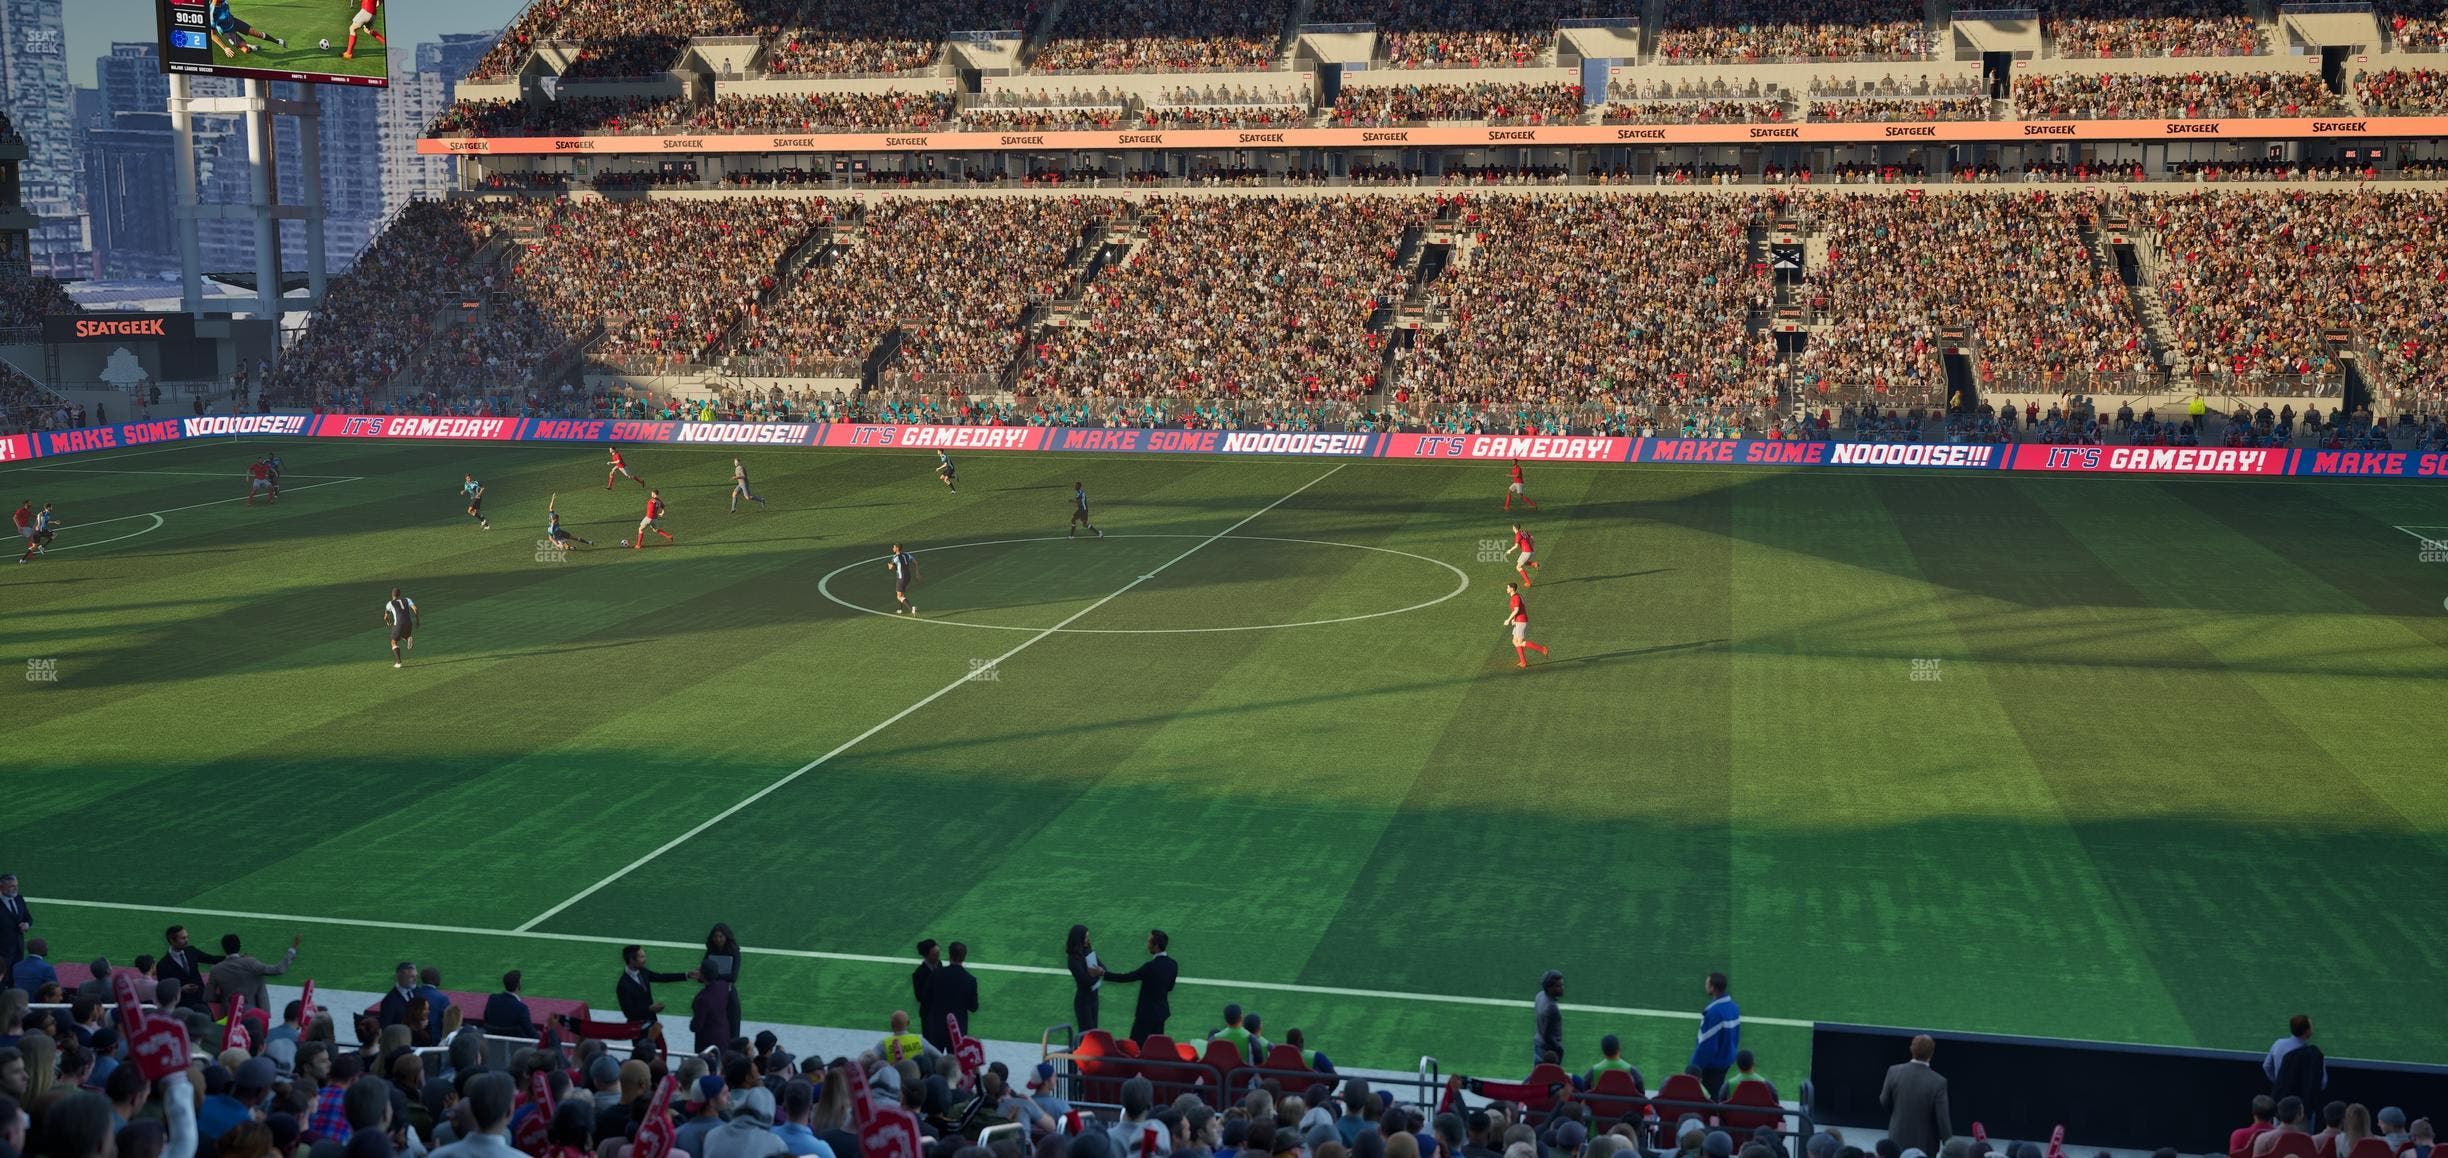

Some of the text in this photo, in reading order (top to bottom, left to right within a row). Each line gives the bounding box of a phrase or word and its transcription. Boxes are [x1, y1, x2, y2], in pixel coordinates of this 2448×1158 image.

[176, 12, 203, 24] 90:00
[193, 35, 200, 45] 2
[1885, 126, 1936, 137] SEATGEEK
[2024, 125, 2075, 135] SEATGEEK
[2167, 123, 2219, 133] SEATGEEK
[2312, 121, 2367, 132] SEATGEEK
[1239, 133, 1284, 143] SEATGEEK
[1362, 132, 1408, 142] SEATGEEK
[1488, 130, 1536, 140] SEATGEEK
[1618, 129, 1666, 139] SEATGEEK
[1750, 128, 1799, 138] SEATGEEK
[663, 139, 703, 148] SEATGEEK
[773, 138, 814, 147] SEATGEEK
[886, 136, 927, 146] SEATGEEK
[1001, 136, 1044, 145] SEATGEEK
[1119, 134, 1162, 144] SEATGEEK
[450, 141, 488, 151] SEATGEEK
[555, 140, 595, 150] SEATGEEK
[75, 318, 166, 338] SEATGEEK
[342, 416, 504, 438] IT'S GAMEDAY!
[534, 420, 809, 444] MAKE SOME NOOOOISE!!!
[50, 416, 305, 454] MAKE SOME NOOOOISE!!!
[849, 426, 1028, 448] IT'S GAMEDAY!
[1063, 430, 1368, 456] MAKE SOME NOOOOISE!!!
[1415, 436, 1613, 460] IT'S GAMEDAY!
[1652, 440, 1993, 467] MAKE SOME NOOOOISE!!!
[2045, 447, 2267, 472] IT'S GAMEDAY!
[2312, 452, 2407, 475] MAKE
